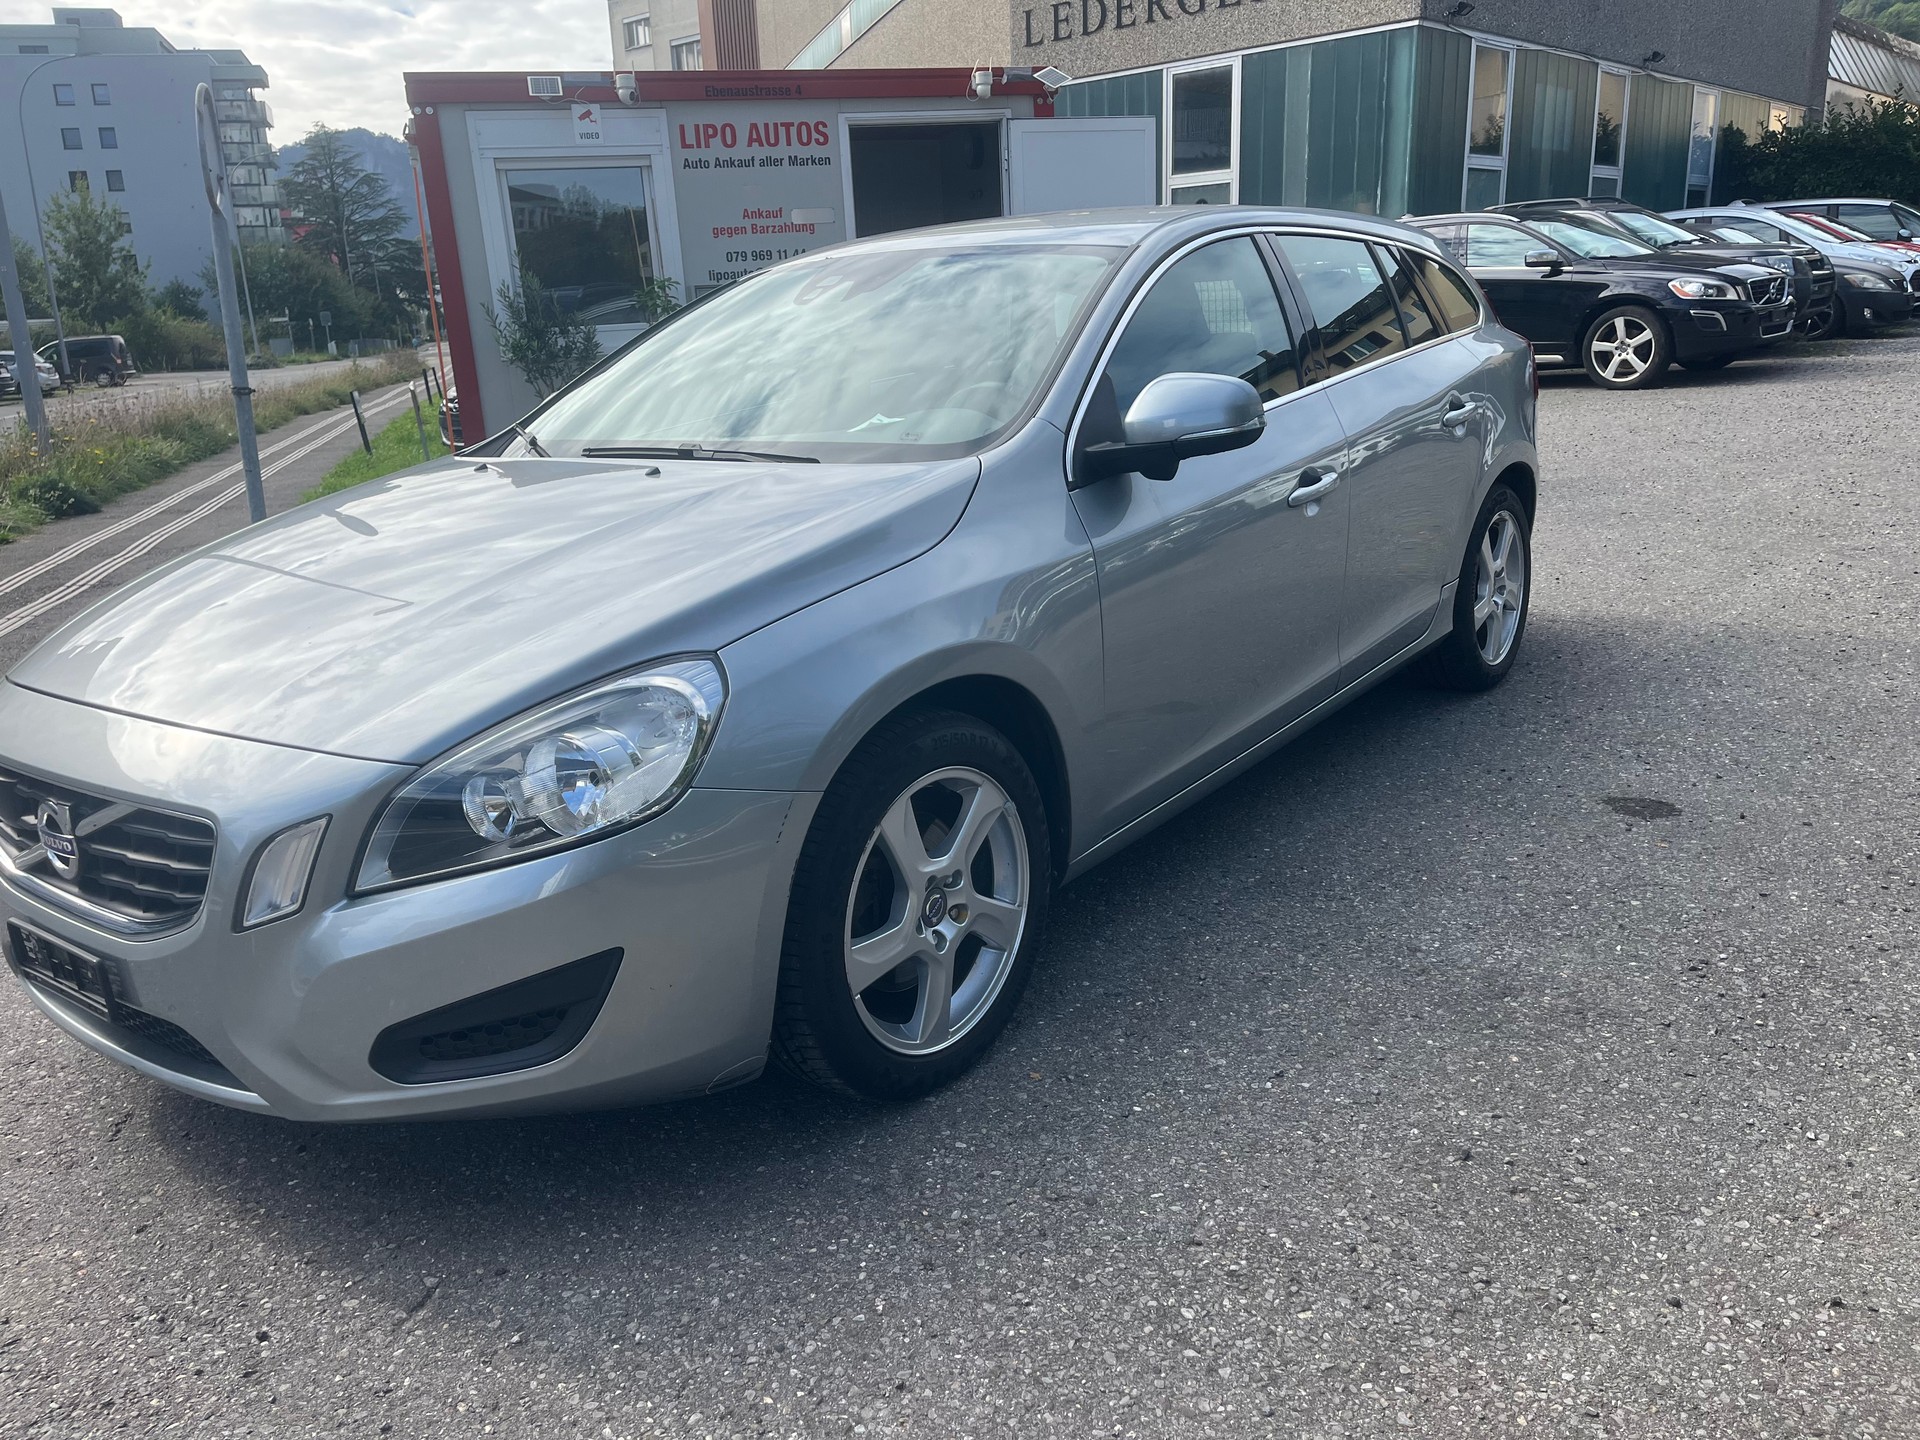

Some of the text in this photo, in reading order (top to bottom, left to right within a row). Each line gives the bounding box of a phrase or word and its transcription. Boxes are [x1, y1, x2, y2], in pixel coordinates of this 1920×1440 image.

[1022, 0, 1265, 47] LEDER
[705, 84, 802, 97] Ebenaustrasse 4
[579, 132, 600, 140] VIDEO
[679, 121, 829, 149] LIPO AUTOS
[683, 154, 831, 169] Auto Ankauf aller Marken
[742, 207, 783, 220] Ankauf
[712, 221, 815, 239] gegen Barzahlung
[726, 251, 748, 262] 079
[751, 250, 773, 261] 969
[776, 249, 788, 260] 11
[708, 267, 763, 283] lipoaut
[42, 834, 71, 851] VOLVO
